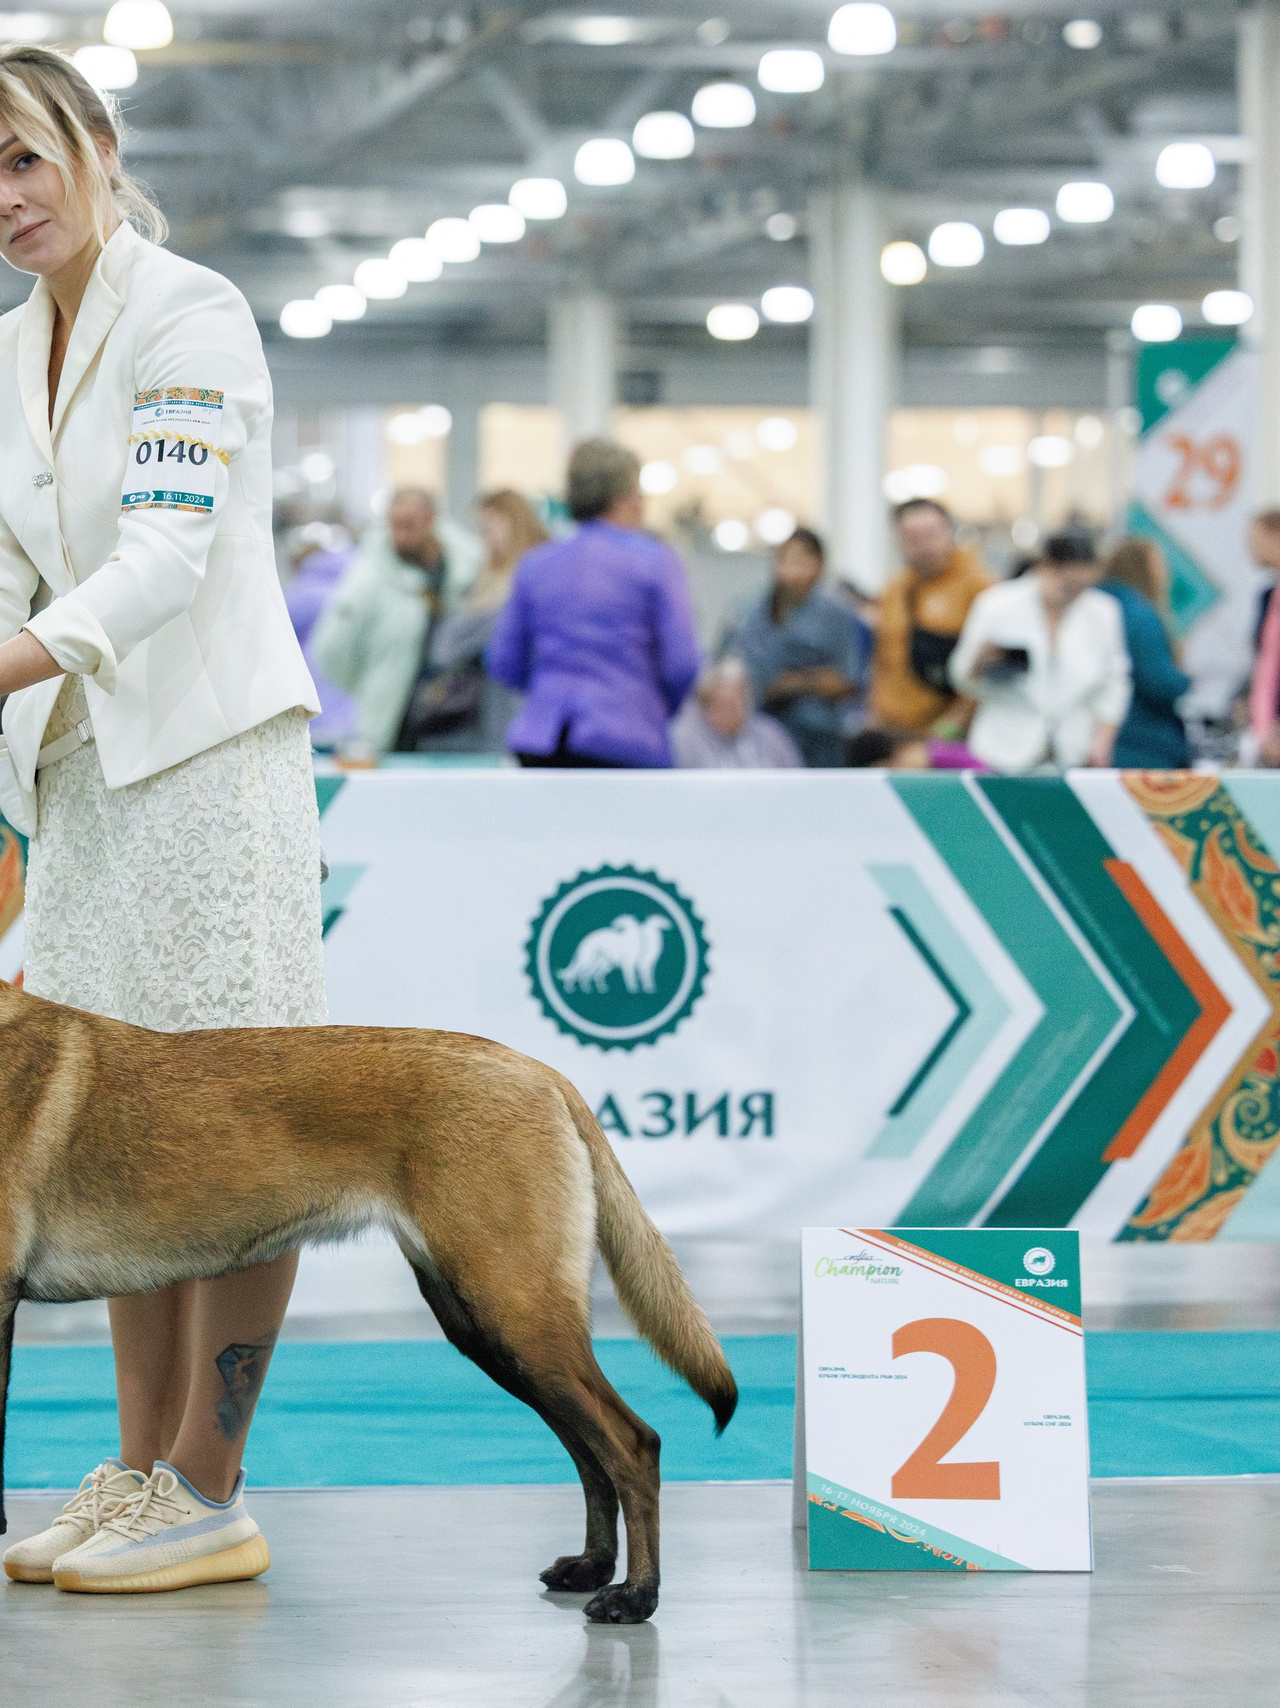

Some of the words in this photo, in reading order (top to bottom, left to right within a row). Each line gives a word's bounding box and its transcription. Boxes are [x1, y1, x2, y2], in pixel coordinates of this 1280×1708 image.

[136, 439, 208, 465] 0140
[1163, 432, 1241, 512] 29
[162, 492, 205, 504] 16.11.2024
[814, 1256, 904, 1281] Champion
[870, 1277, 900, 1285] NATURE
[1014, 1278, 1069, 1287] ЕВРАЗИЯ
[891, 1317, 1001, 1500] 2
[821, 1483, 849, 1501] 16-17
[850, 1497, 899, 1524] НОЯБРЯ
[898, 1519, 927, 1536] 2024
